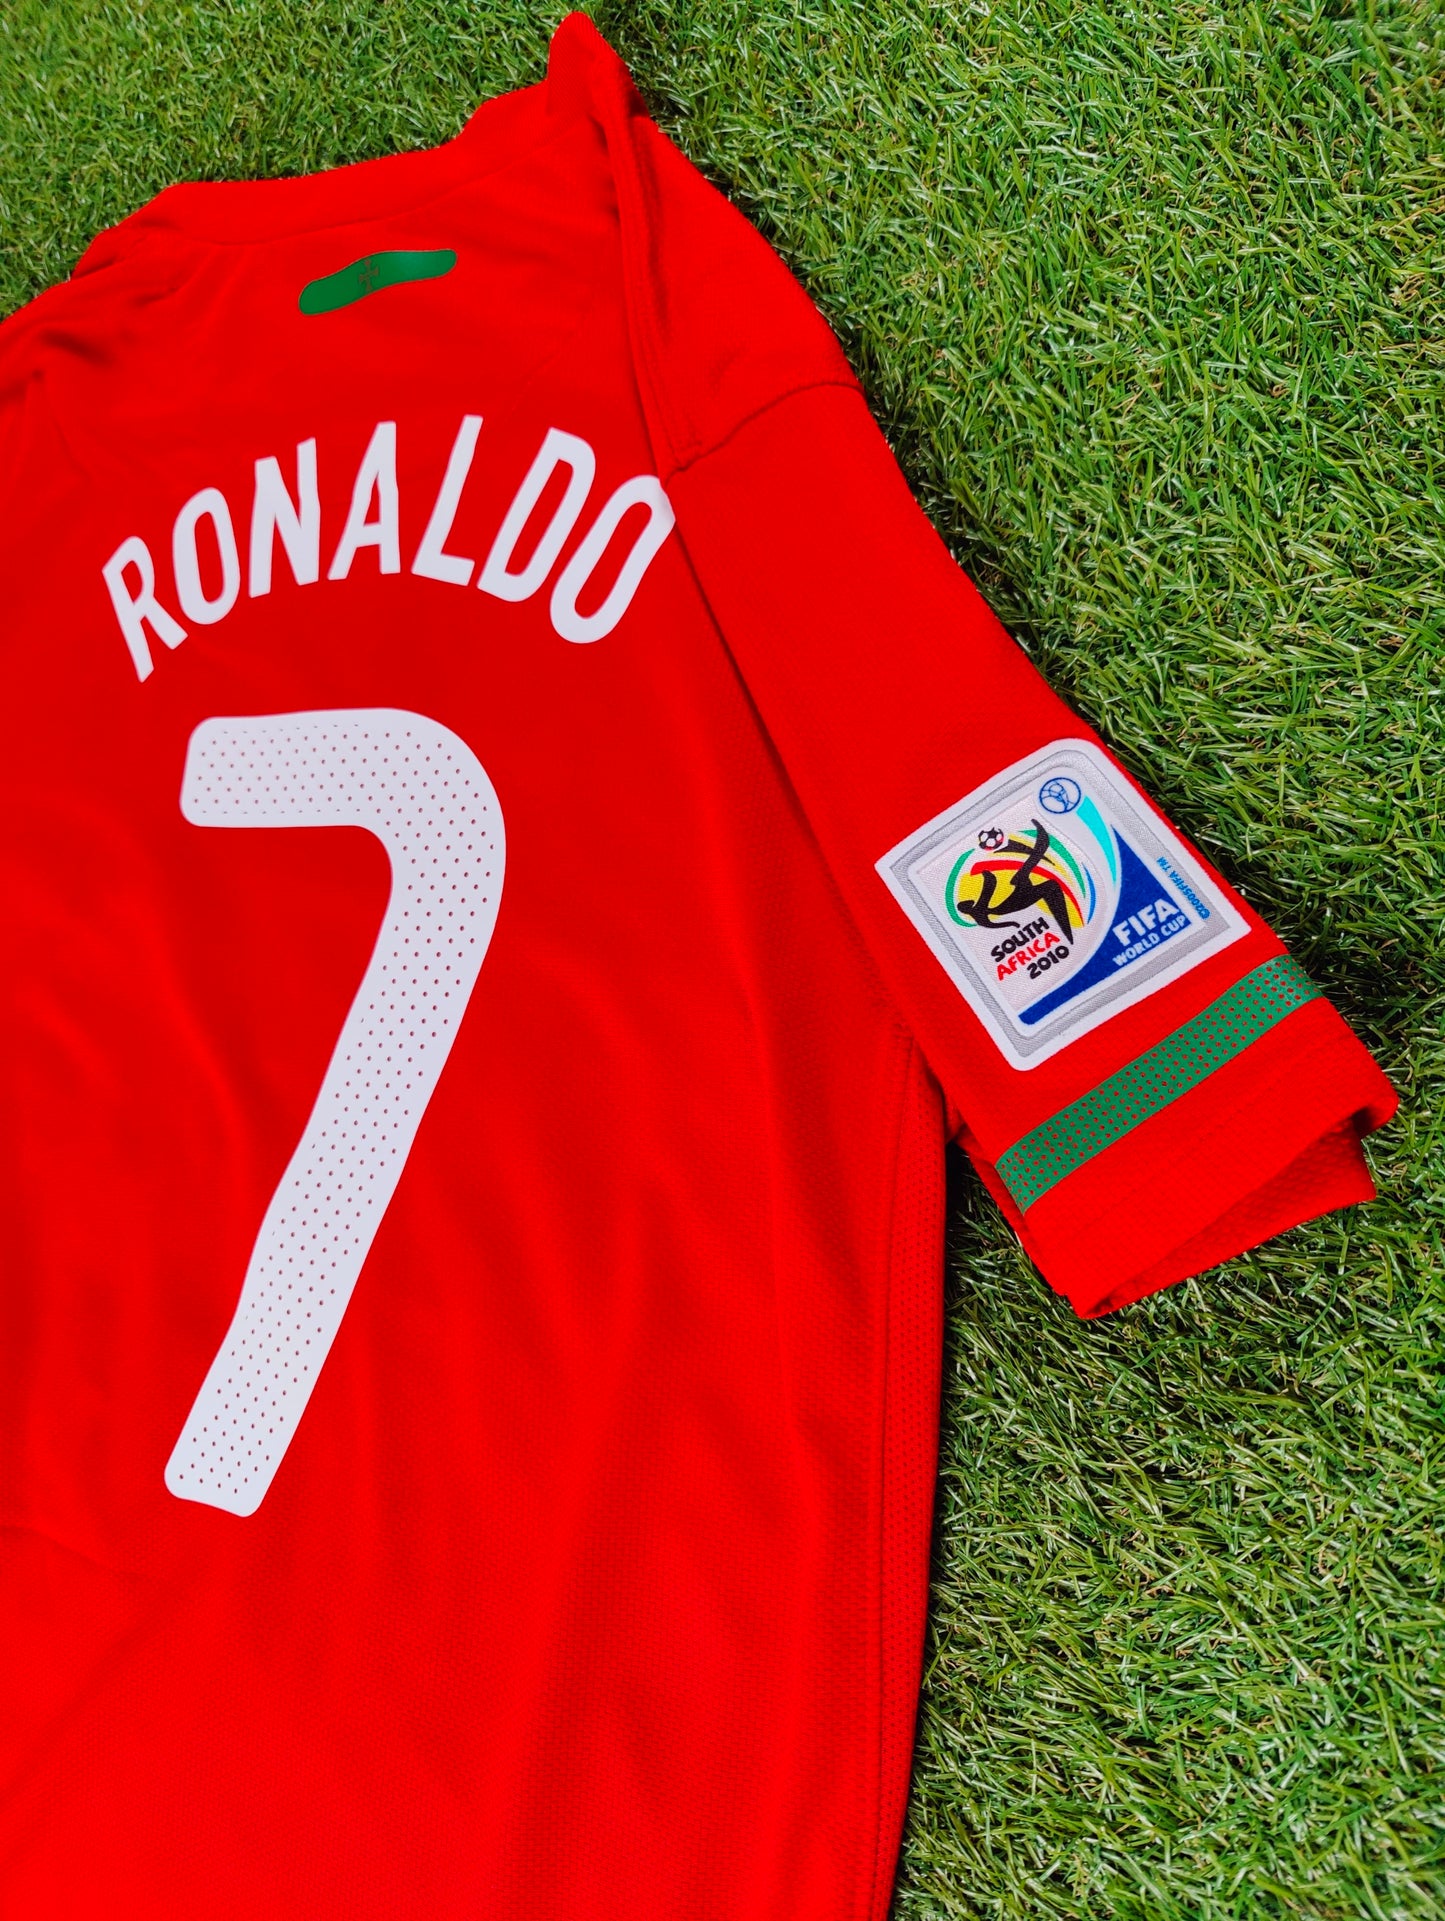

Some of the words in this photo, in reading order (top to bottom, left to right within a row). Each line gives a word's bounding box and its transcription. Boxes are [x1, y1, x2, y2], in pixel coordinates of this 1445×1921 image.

[102, 414, 675, 682] RONALDO
[991, 917, 1049, 962] SOUTH
[1112, 898, 1179, 946] FIFA
[1112, 932, 1160, 966] WORLD
[1160, 915, 1186, 936] CUP
[997, 932, 1060, 981] AFRICA
[1027, 946, 1069, 979] 2010
[165, 708, 506, 1516] 7
